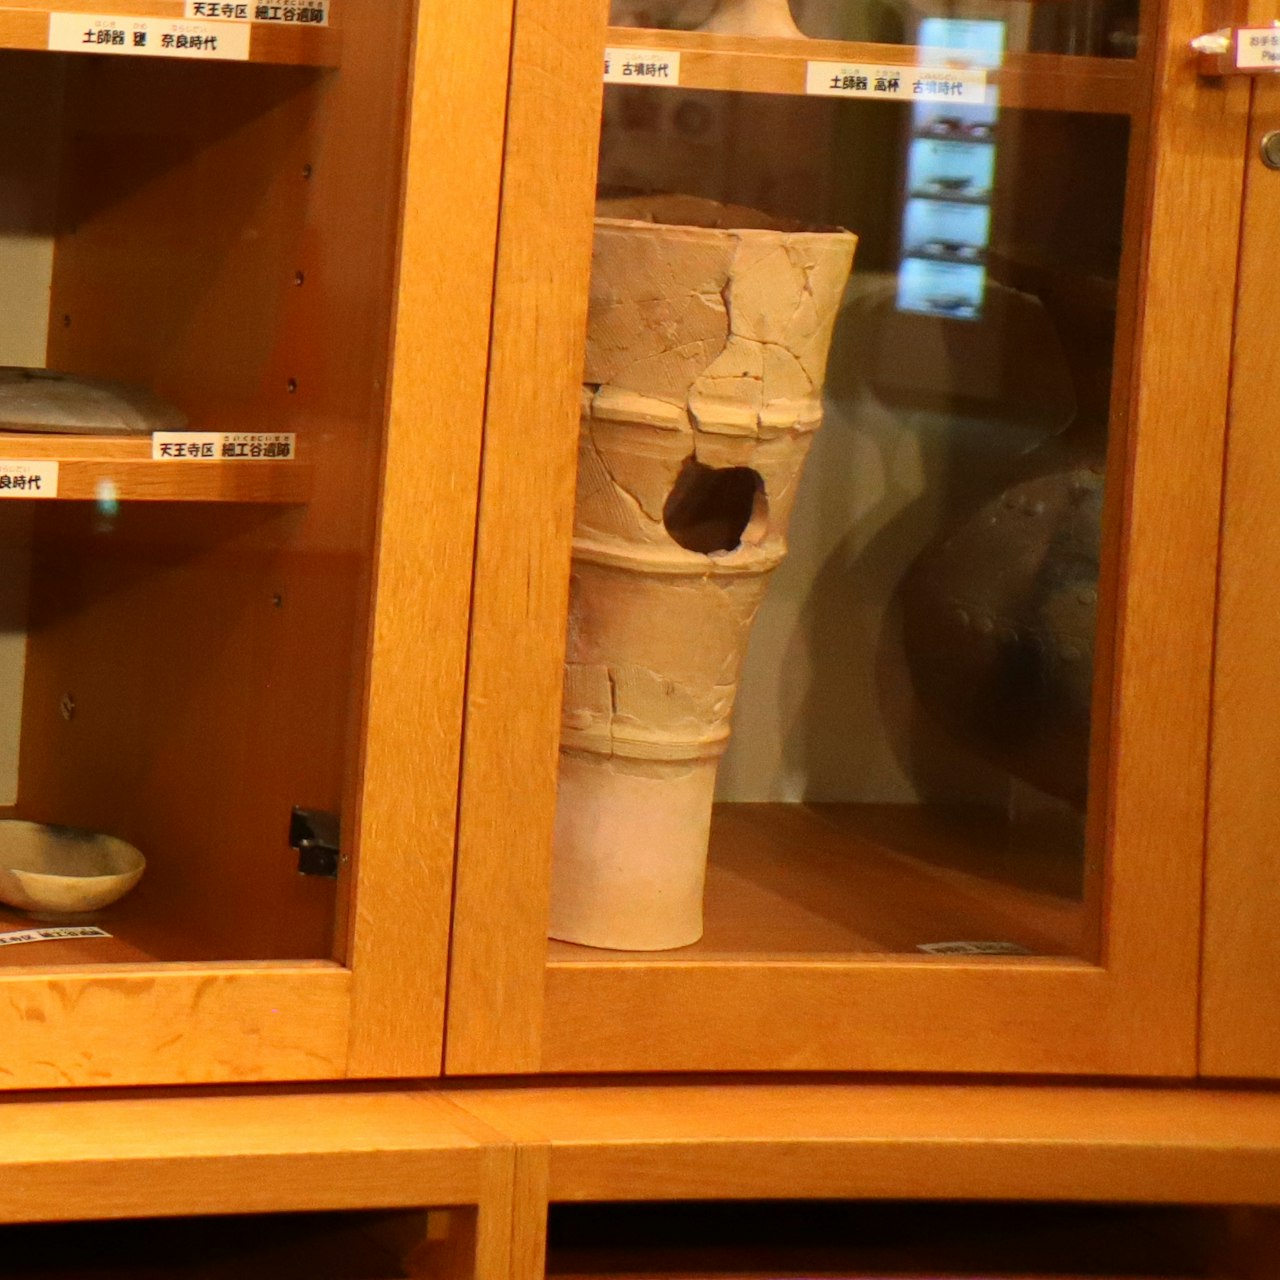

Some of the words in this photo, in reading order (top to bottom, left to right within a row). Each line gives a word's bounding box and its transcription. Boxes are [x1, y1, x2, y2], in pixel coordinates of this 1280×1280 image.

[193, 2, 248, 19] 天王寺区
[255, 5, 325, 24] 細工谷遺跡
[82, 29, 126, 46] 土師器
[161, 33, 218, 51] 奈良時代
[622, 61, 669, 78] 古墳時代
[829, 75, 868, 91] 土師器
[874, 77, 900, 93] 高杯
[912, 80, 963, 96] 古墳時代
[160, 442, 214, 457] 天王寺区
[222, 442, 291, 458] 細工谷遺跡
